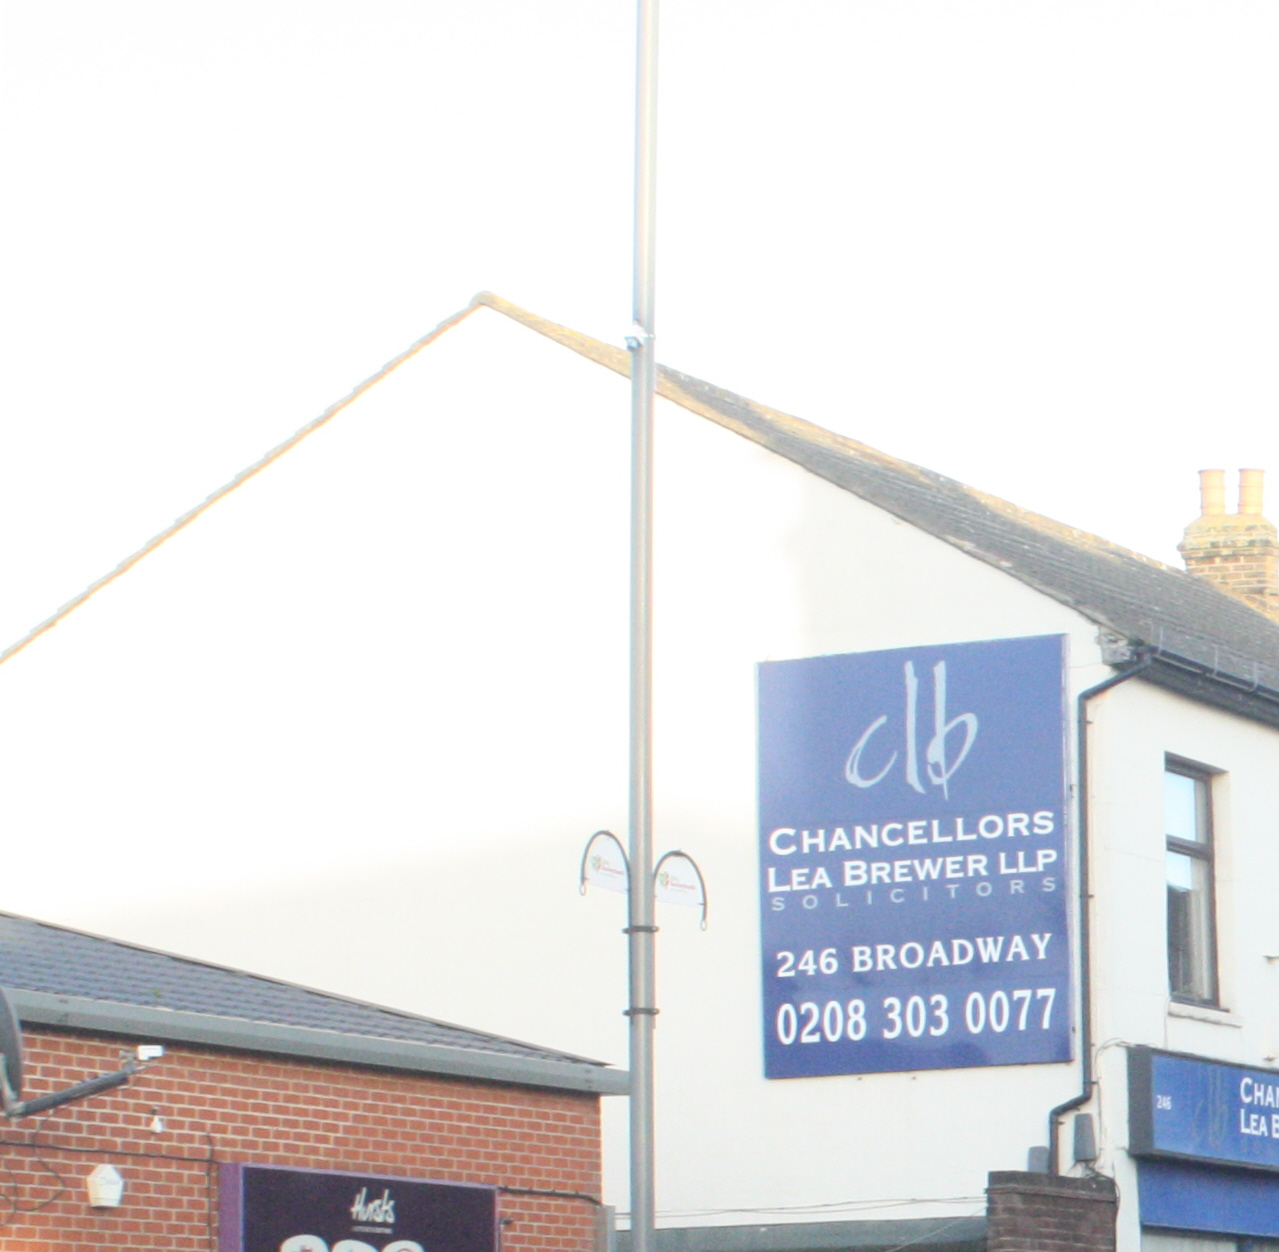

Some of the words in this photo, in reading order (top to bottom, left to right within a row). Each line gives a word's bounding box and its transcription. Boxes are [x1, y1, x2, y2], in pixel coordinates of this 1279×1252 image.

[846, 660, 978, 800] clb
[769, 811, 1054, 856] CHANCELLORS
[768, 866, 832, 893] LEA
[844, 853, 988, 887] BREWER
[1000, 849, 1057, 875] LLP
[772, 876, 1056, 911] SOLICITORS
[776, 948, 839, 978] 246
[853, 933, 1053, 973] BROADWAY
[776, 999, 867, 1046] 0208
[883, 994, 949, 1039] 303
[965, 988, 1057, 1035] 0077
[1240, 1108, 1268, 1137] LEA
